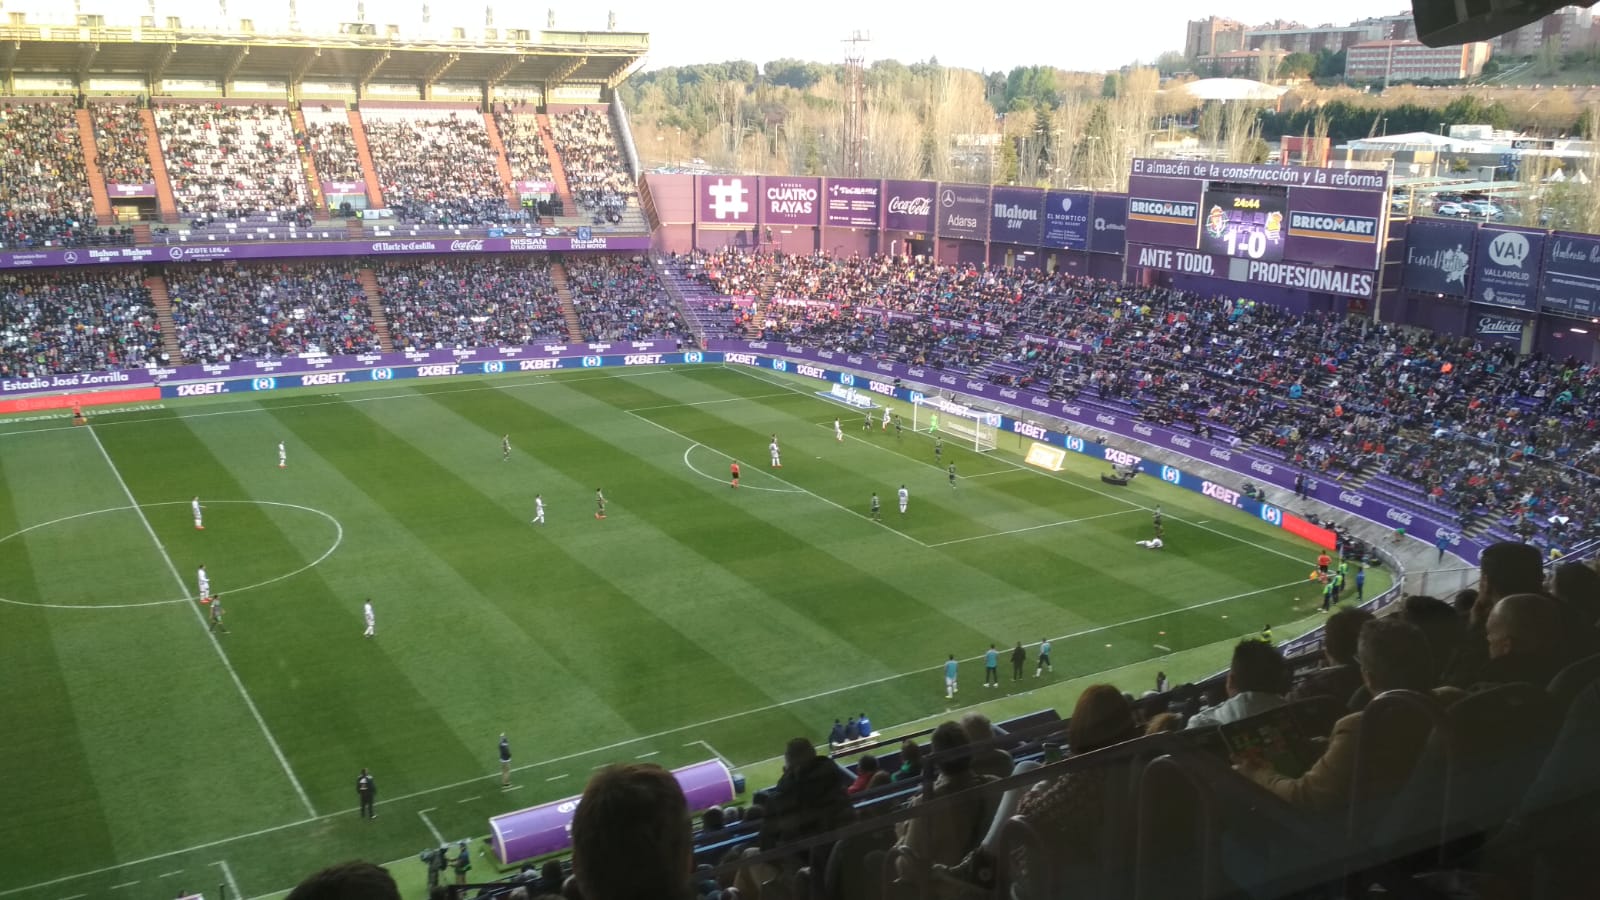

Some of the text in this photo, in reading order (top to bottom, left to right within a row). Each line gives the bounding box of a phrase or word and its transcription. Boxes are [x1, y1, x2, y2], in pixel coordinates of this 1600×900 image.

[1134, 160, 1383, 188] El almacén de la construcción y la reforma
[767, 187, 818, 201] CUATRO
[771, 200, 813, 214] RAYAS
[1131, 202, 1195, 217] BRICOMART
[1233, 197, 1260, 209] 24:44
[994, 203, 1037, 220] Mahou
[947, 213, 977, 228] Adarsa
[1007, 219, 1022, 229] SIN
[1292, 215, 1374, 236] BRICOMART
[1494, 240, 1523, 261] VA!
[1139, 247, 1215, 276] ANTE TODO,
[1249, 260, 1372, 297] PROFESIONALES
[1484, 267, 1530, 281] VALLADOLID
[1477, 317, 1521, 334] Galicia
[520, 359, 559, 370] 1XBET
[624, 354, 662, 365] 1XBET
[725, 353, 757, 366] 1XBET
[418, 364, 459, 377] 1XBET
[797, 365, 825, 379] 1XBET
[3, 371, 129, 391] Estadio José Zorrilla
[301, 373, 346, 386] 1XBET
[177, 382, 224, 397] 1XBET
[869, 380, 895, 395] 1XBET
[1201, 481, 1241, 506] 1XBET
